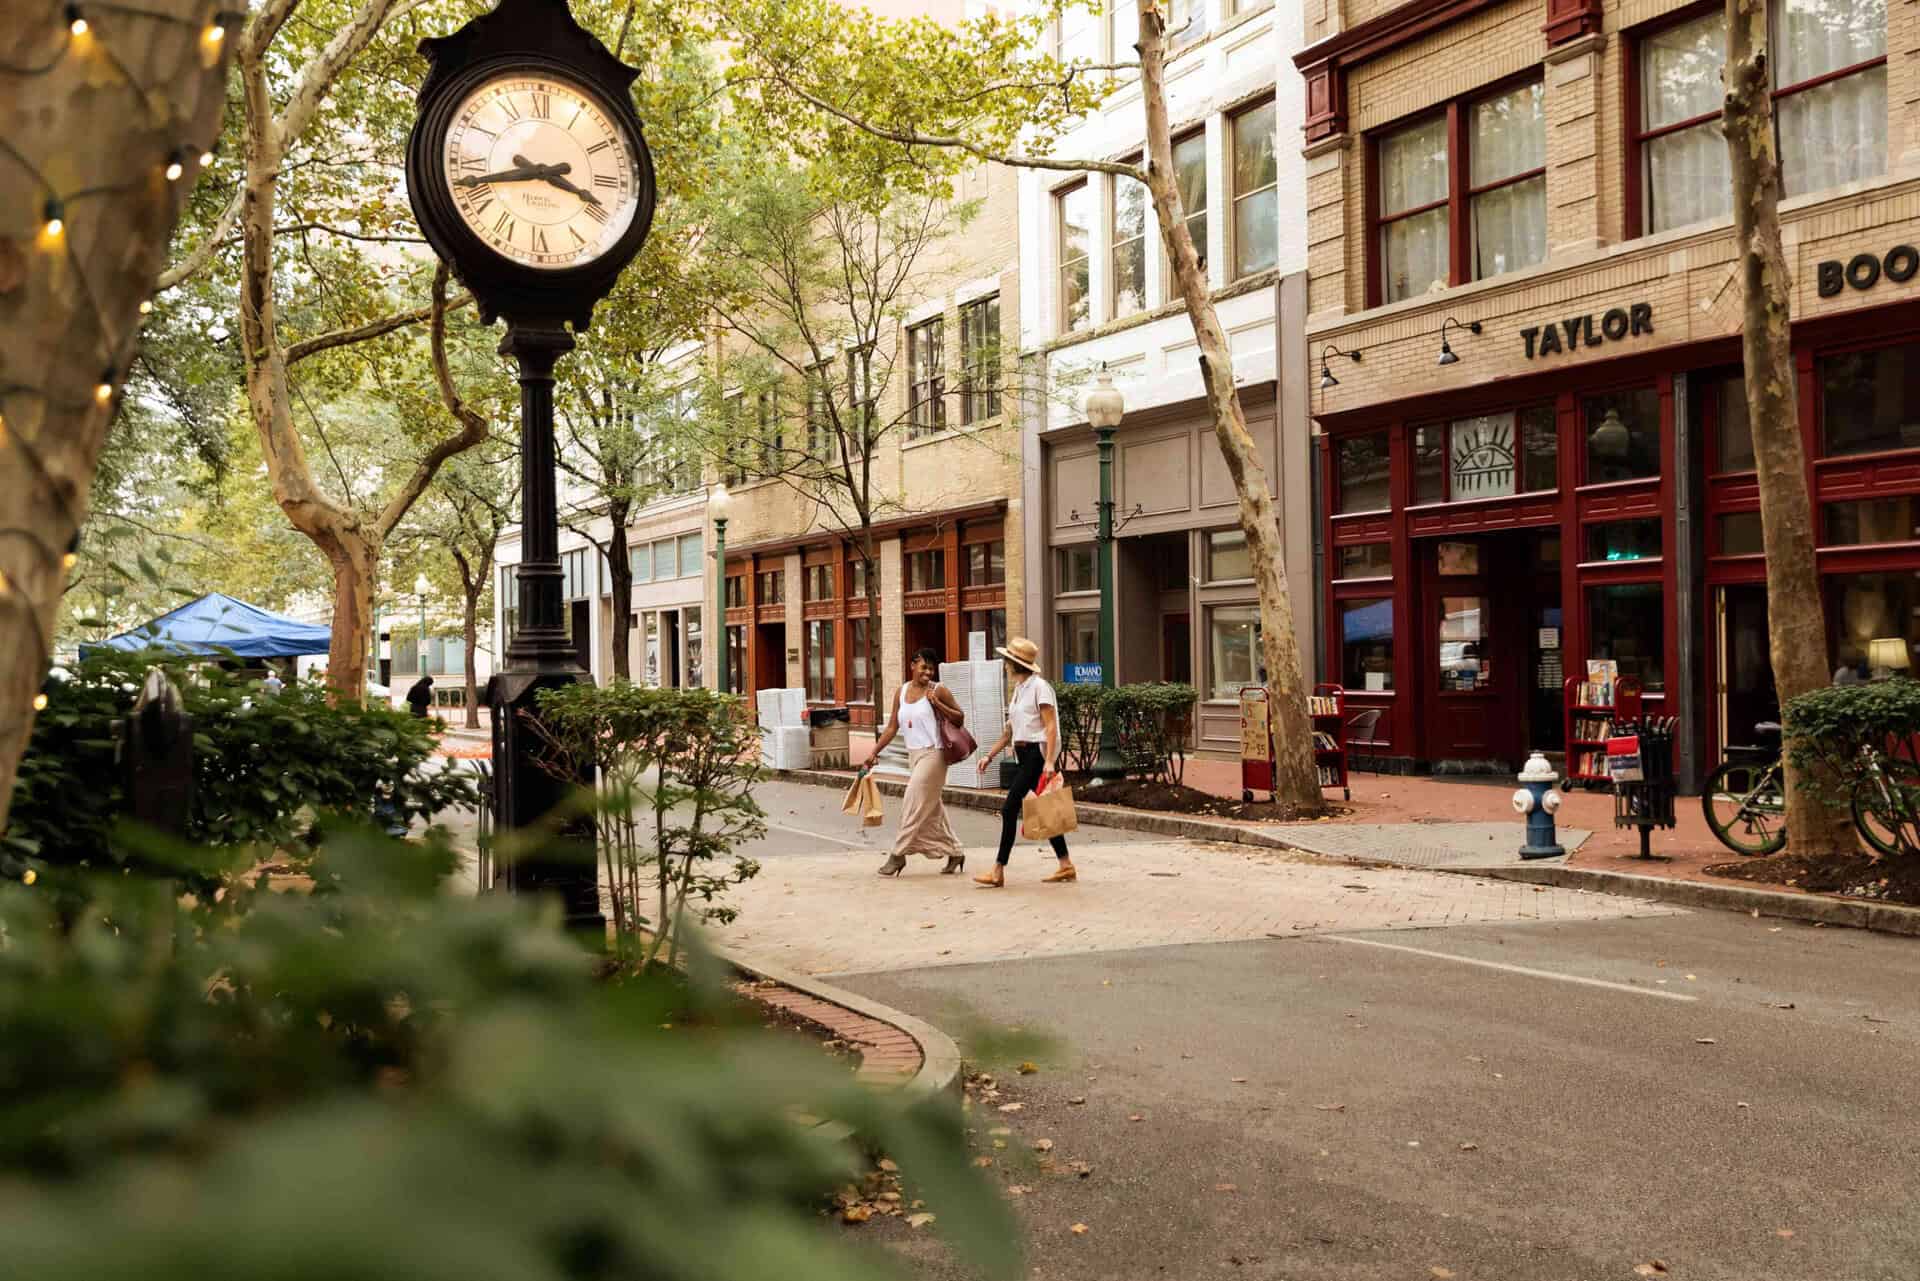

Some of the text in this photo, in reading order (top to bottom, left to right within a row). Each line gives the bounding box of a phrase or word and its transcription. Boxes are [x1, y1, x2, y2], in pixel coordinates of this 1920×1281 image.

[531, 93, 550, 120] XII
[585, 140, 611, 155] II
[593, 174, 619, 189] III
[1520, 244, 1919, 358] TAYLOR BOO
